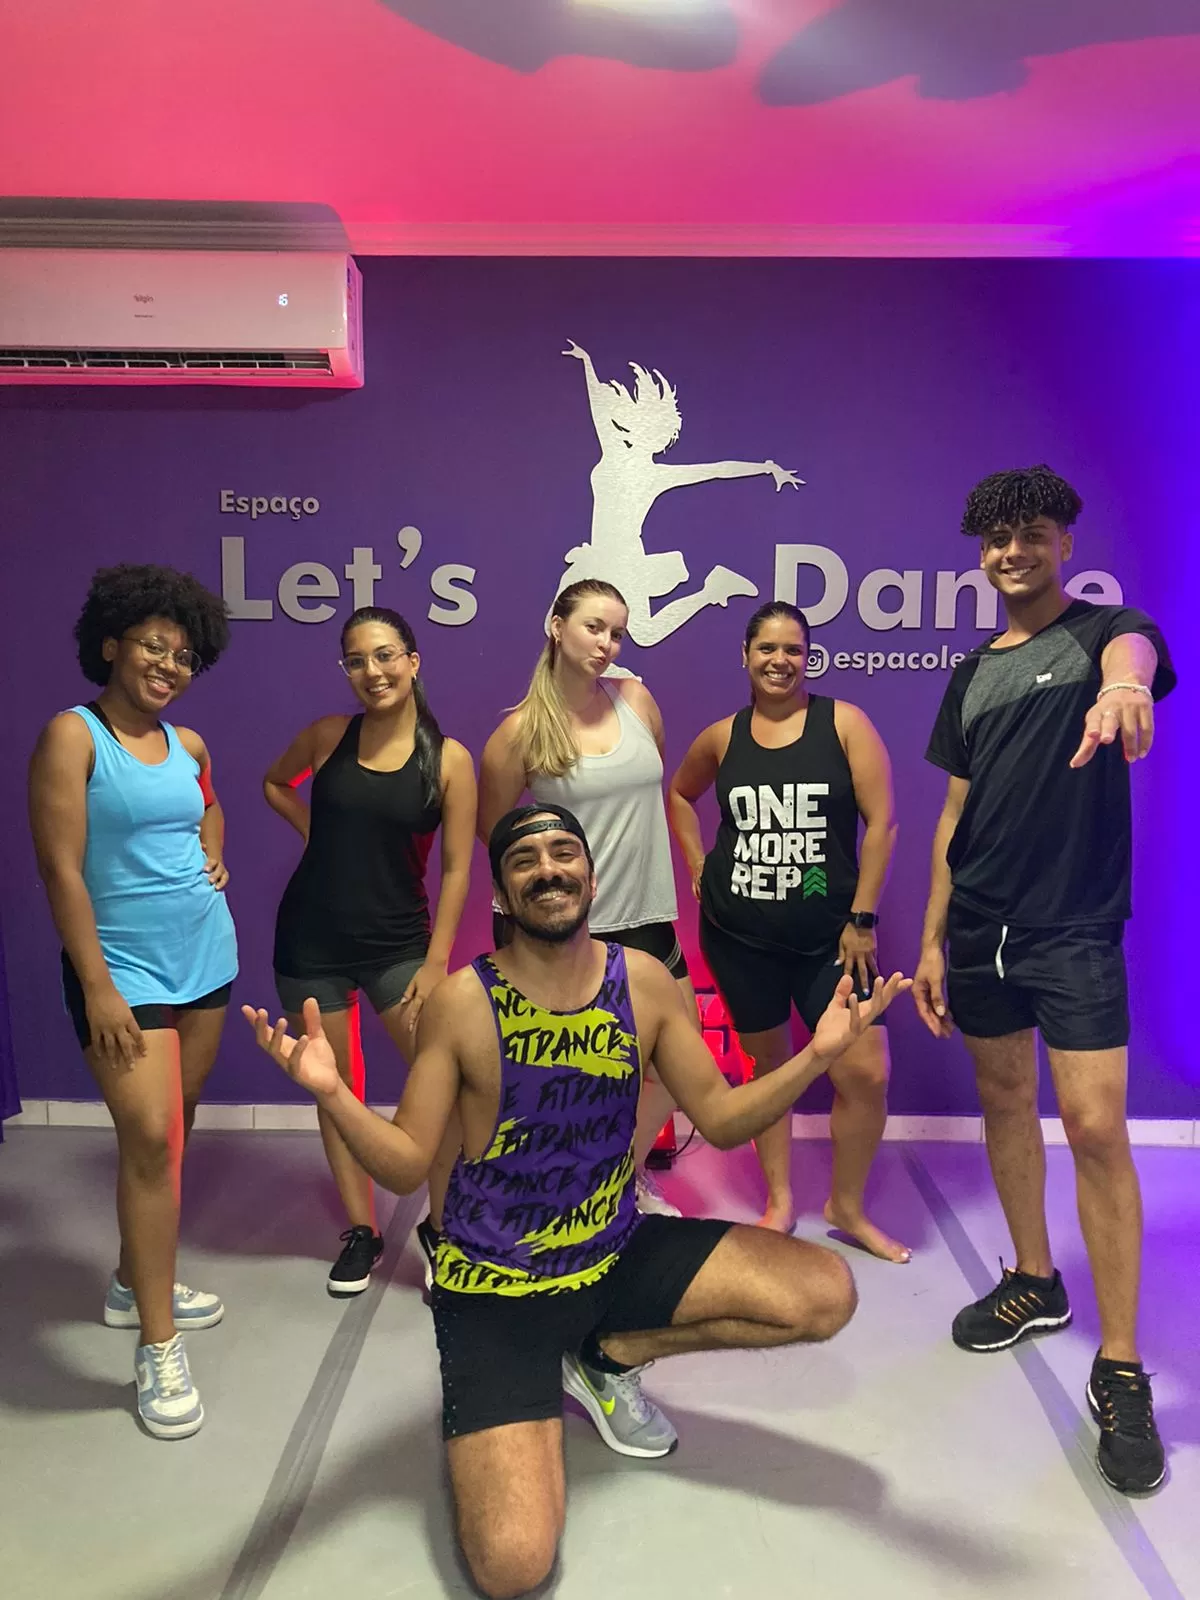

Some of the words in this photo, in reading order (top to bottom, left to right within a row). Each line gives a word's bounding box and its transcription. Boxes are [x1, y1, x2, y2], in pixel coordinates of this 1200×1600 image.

[220, 489, 320, 520] Espaço
[221, 526, 479, 626] Let's
[773, 543, 1125, 632] Dane
[728, 783, 829, 831] ONE
[733, 831, 828, 865] MORE
[730, 861, 802, 901] REP
